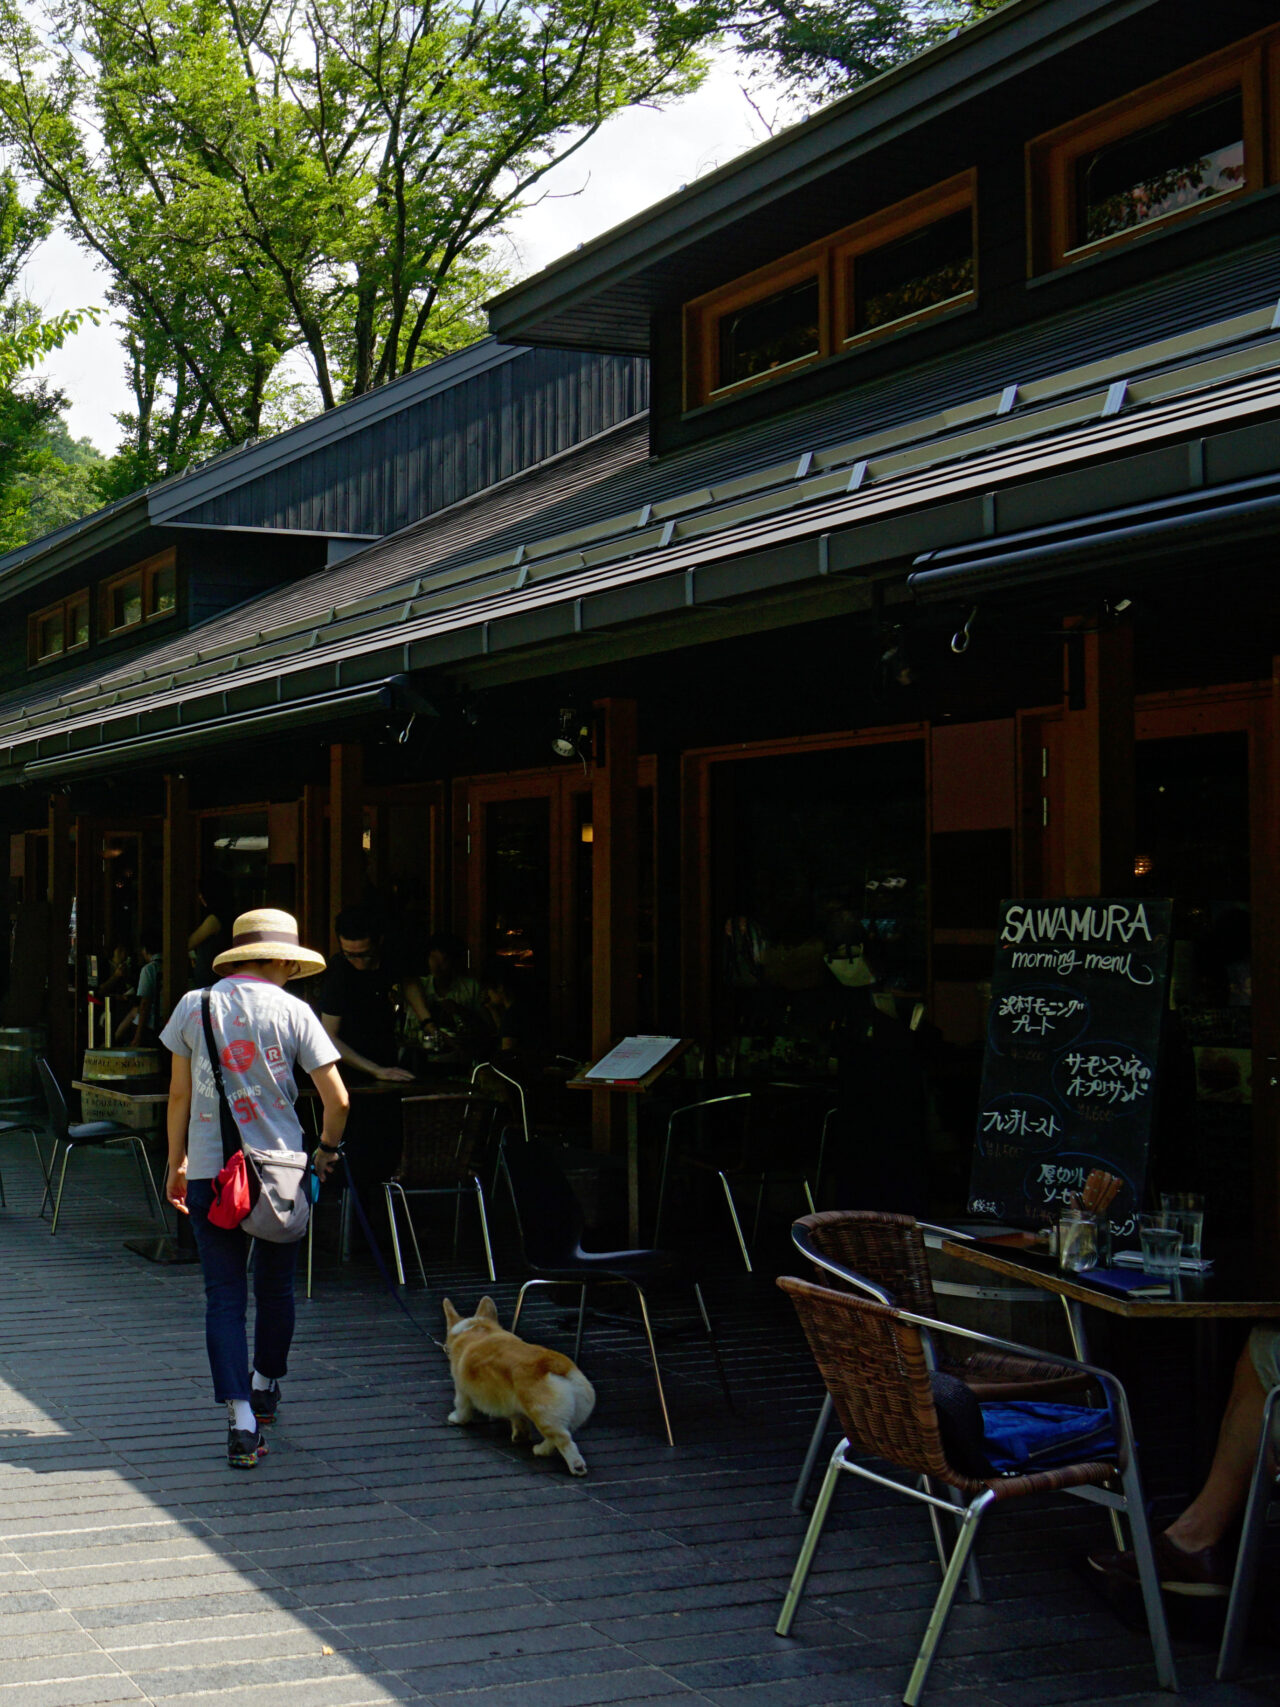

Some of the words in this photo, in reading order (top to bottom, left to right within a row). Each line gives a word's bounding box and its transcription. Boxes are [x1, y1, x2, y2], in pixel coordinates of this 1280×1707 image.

[1000, 903, 1153, 943] SAWAMURA
[1011, 949, 1084, 976] morning
[1084, 952, 1154, 985] menu
[1011, 1014, 1057, 1036] プレート
[982, 1108, 1062, 1138] フレンチトースト
